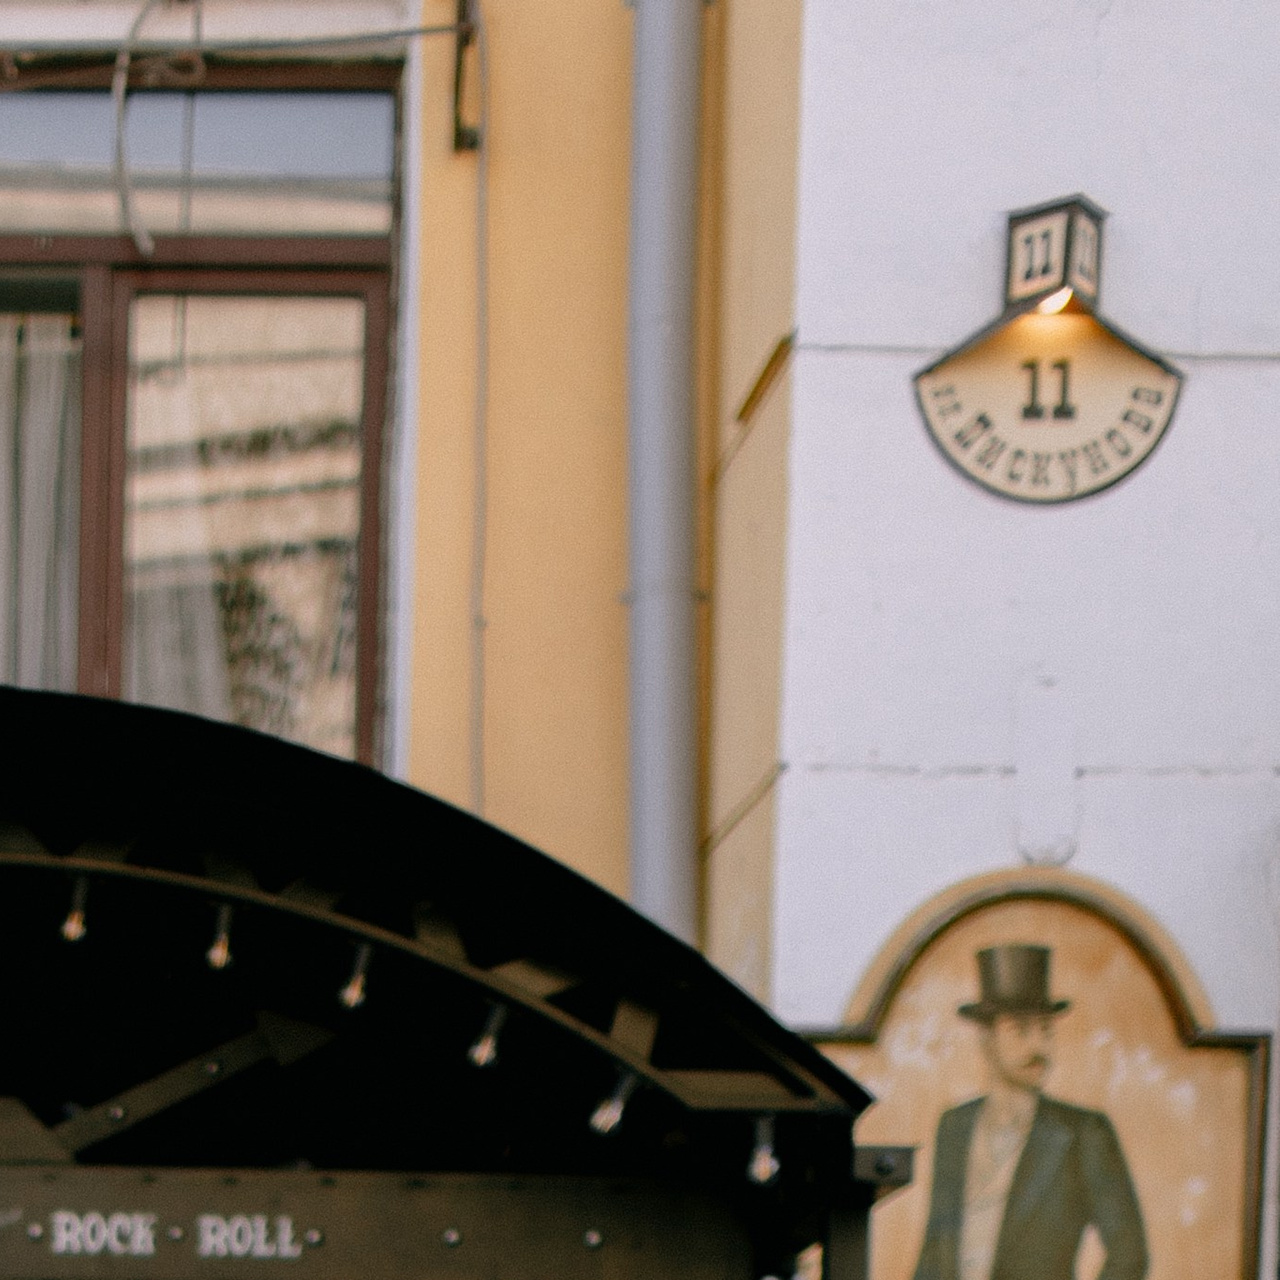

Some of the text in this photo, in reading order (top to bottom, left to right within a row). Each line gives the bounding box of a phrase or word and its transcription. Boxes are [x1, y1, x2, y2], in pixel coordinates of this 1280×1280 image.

[1021, 357, 1075, 420] 11
[50, 1210, 157, 1256] ROCK
[196, 1213, 303, 1260] ROLL
